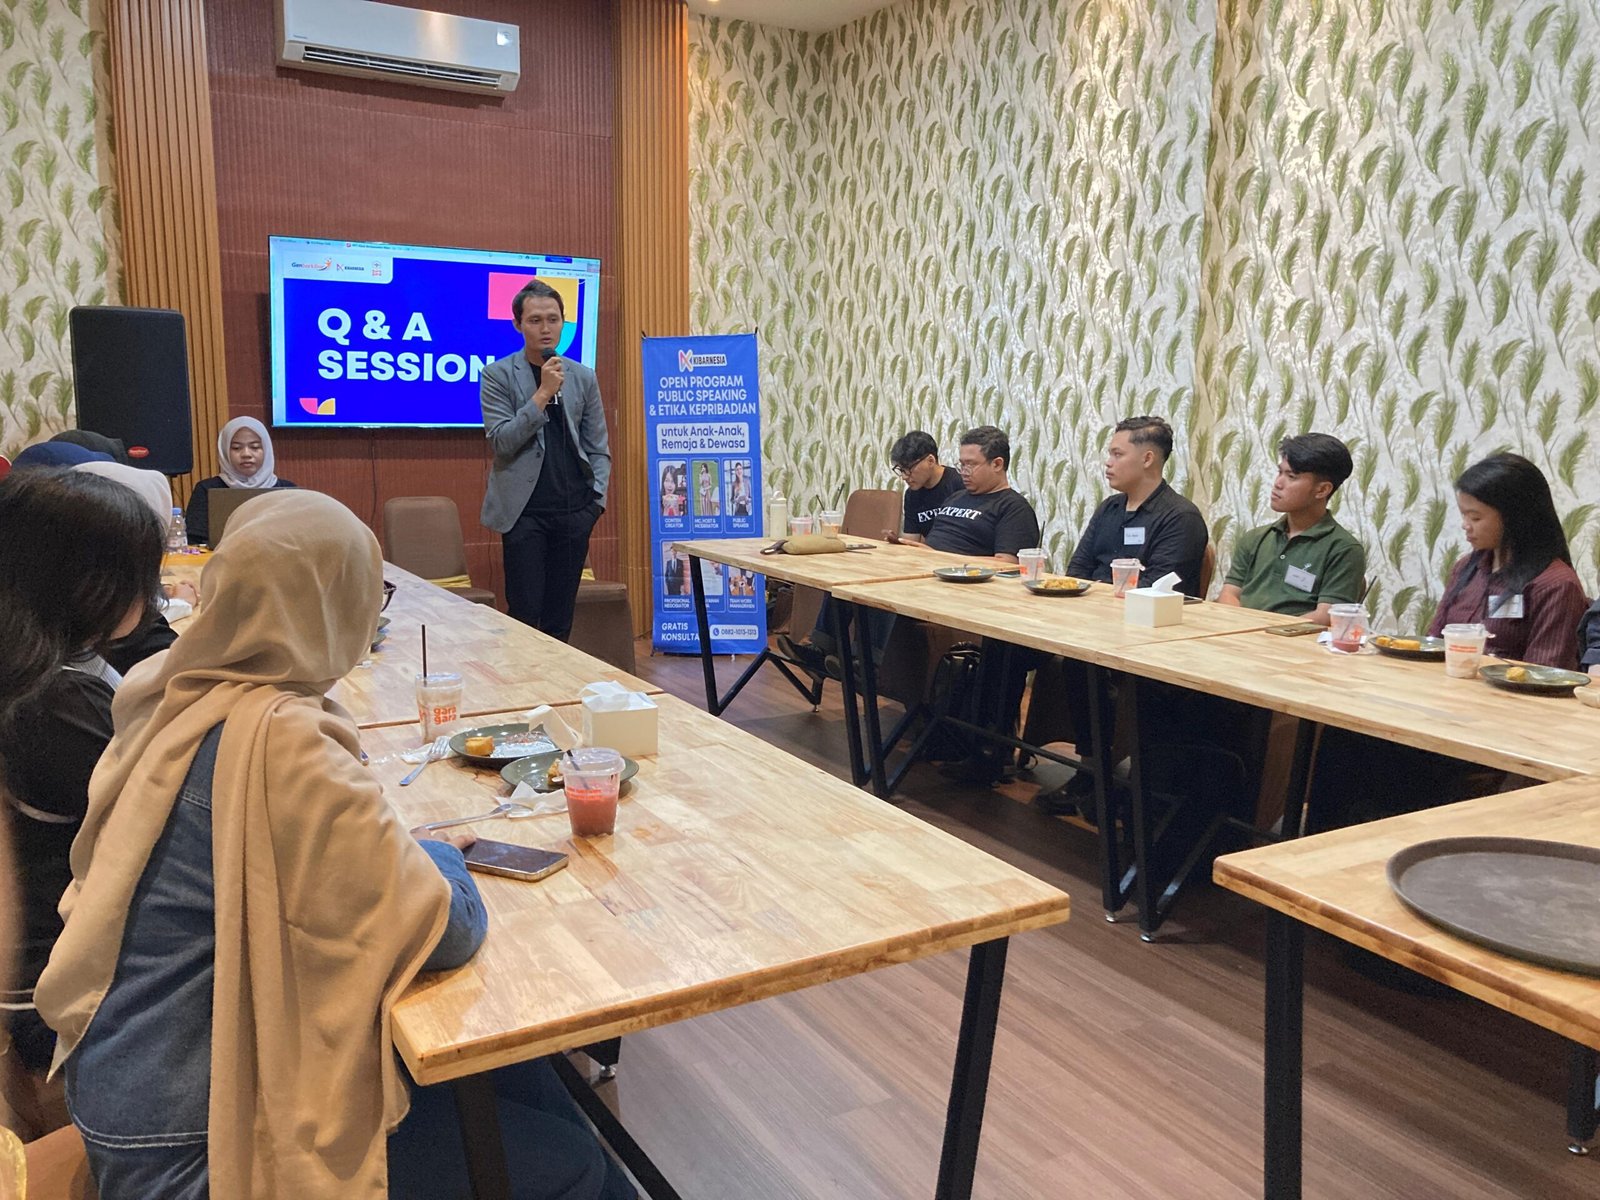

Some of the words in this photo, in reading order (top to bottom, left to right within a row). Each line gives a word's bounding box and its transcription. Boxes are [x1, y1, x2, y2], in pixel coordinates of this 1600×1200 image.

[318, 308, 351, 345] Q
[362, 310, 392, 340] &
[402, 312, 432, 341] A
[318, 349, 495, 382] SESSION
[693, 355, 725, 365] KIBARNESIA
[660, 377, 688, 388] OPEN
[690, 375, 743, 387] PROGRAM
[658, 390, 694, 402] PUBLIC
[696, 389, 747, 401] SPEAKING
[649, 404, 656, 416] &
[658, 404, 687, 415] ETIKA
[689, 403, 756, 415] KEPRIBADIAN
[661, 427, 689, 437] untuk
[690, 425, 745, 437] Anak-Anak,
[661, 438, 697, 451] Remaja
[700, 439, 706, 449] &
[707, 438, 745, 449] Dewasa
[661, 622, 688, 631] GRATIS
